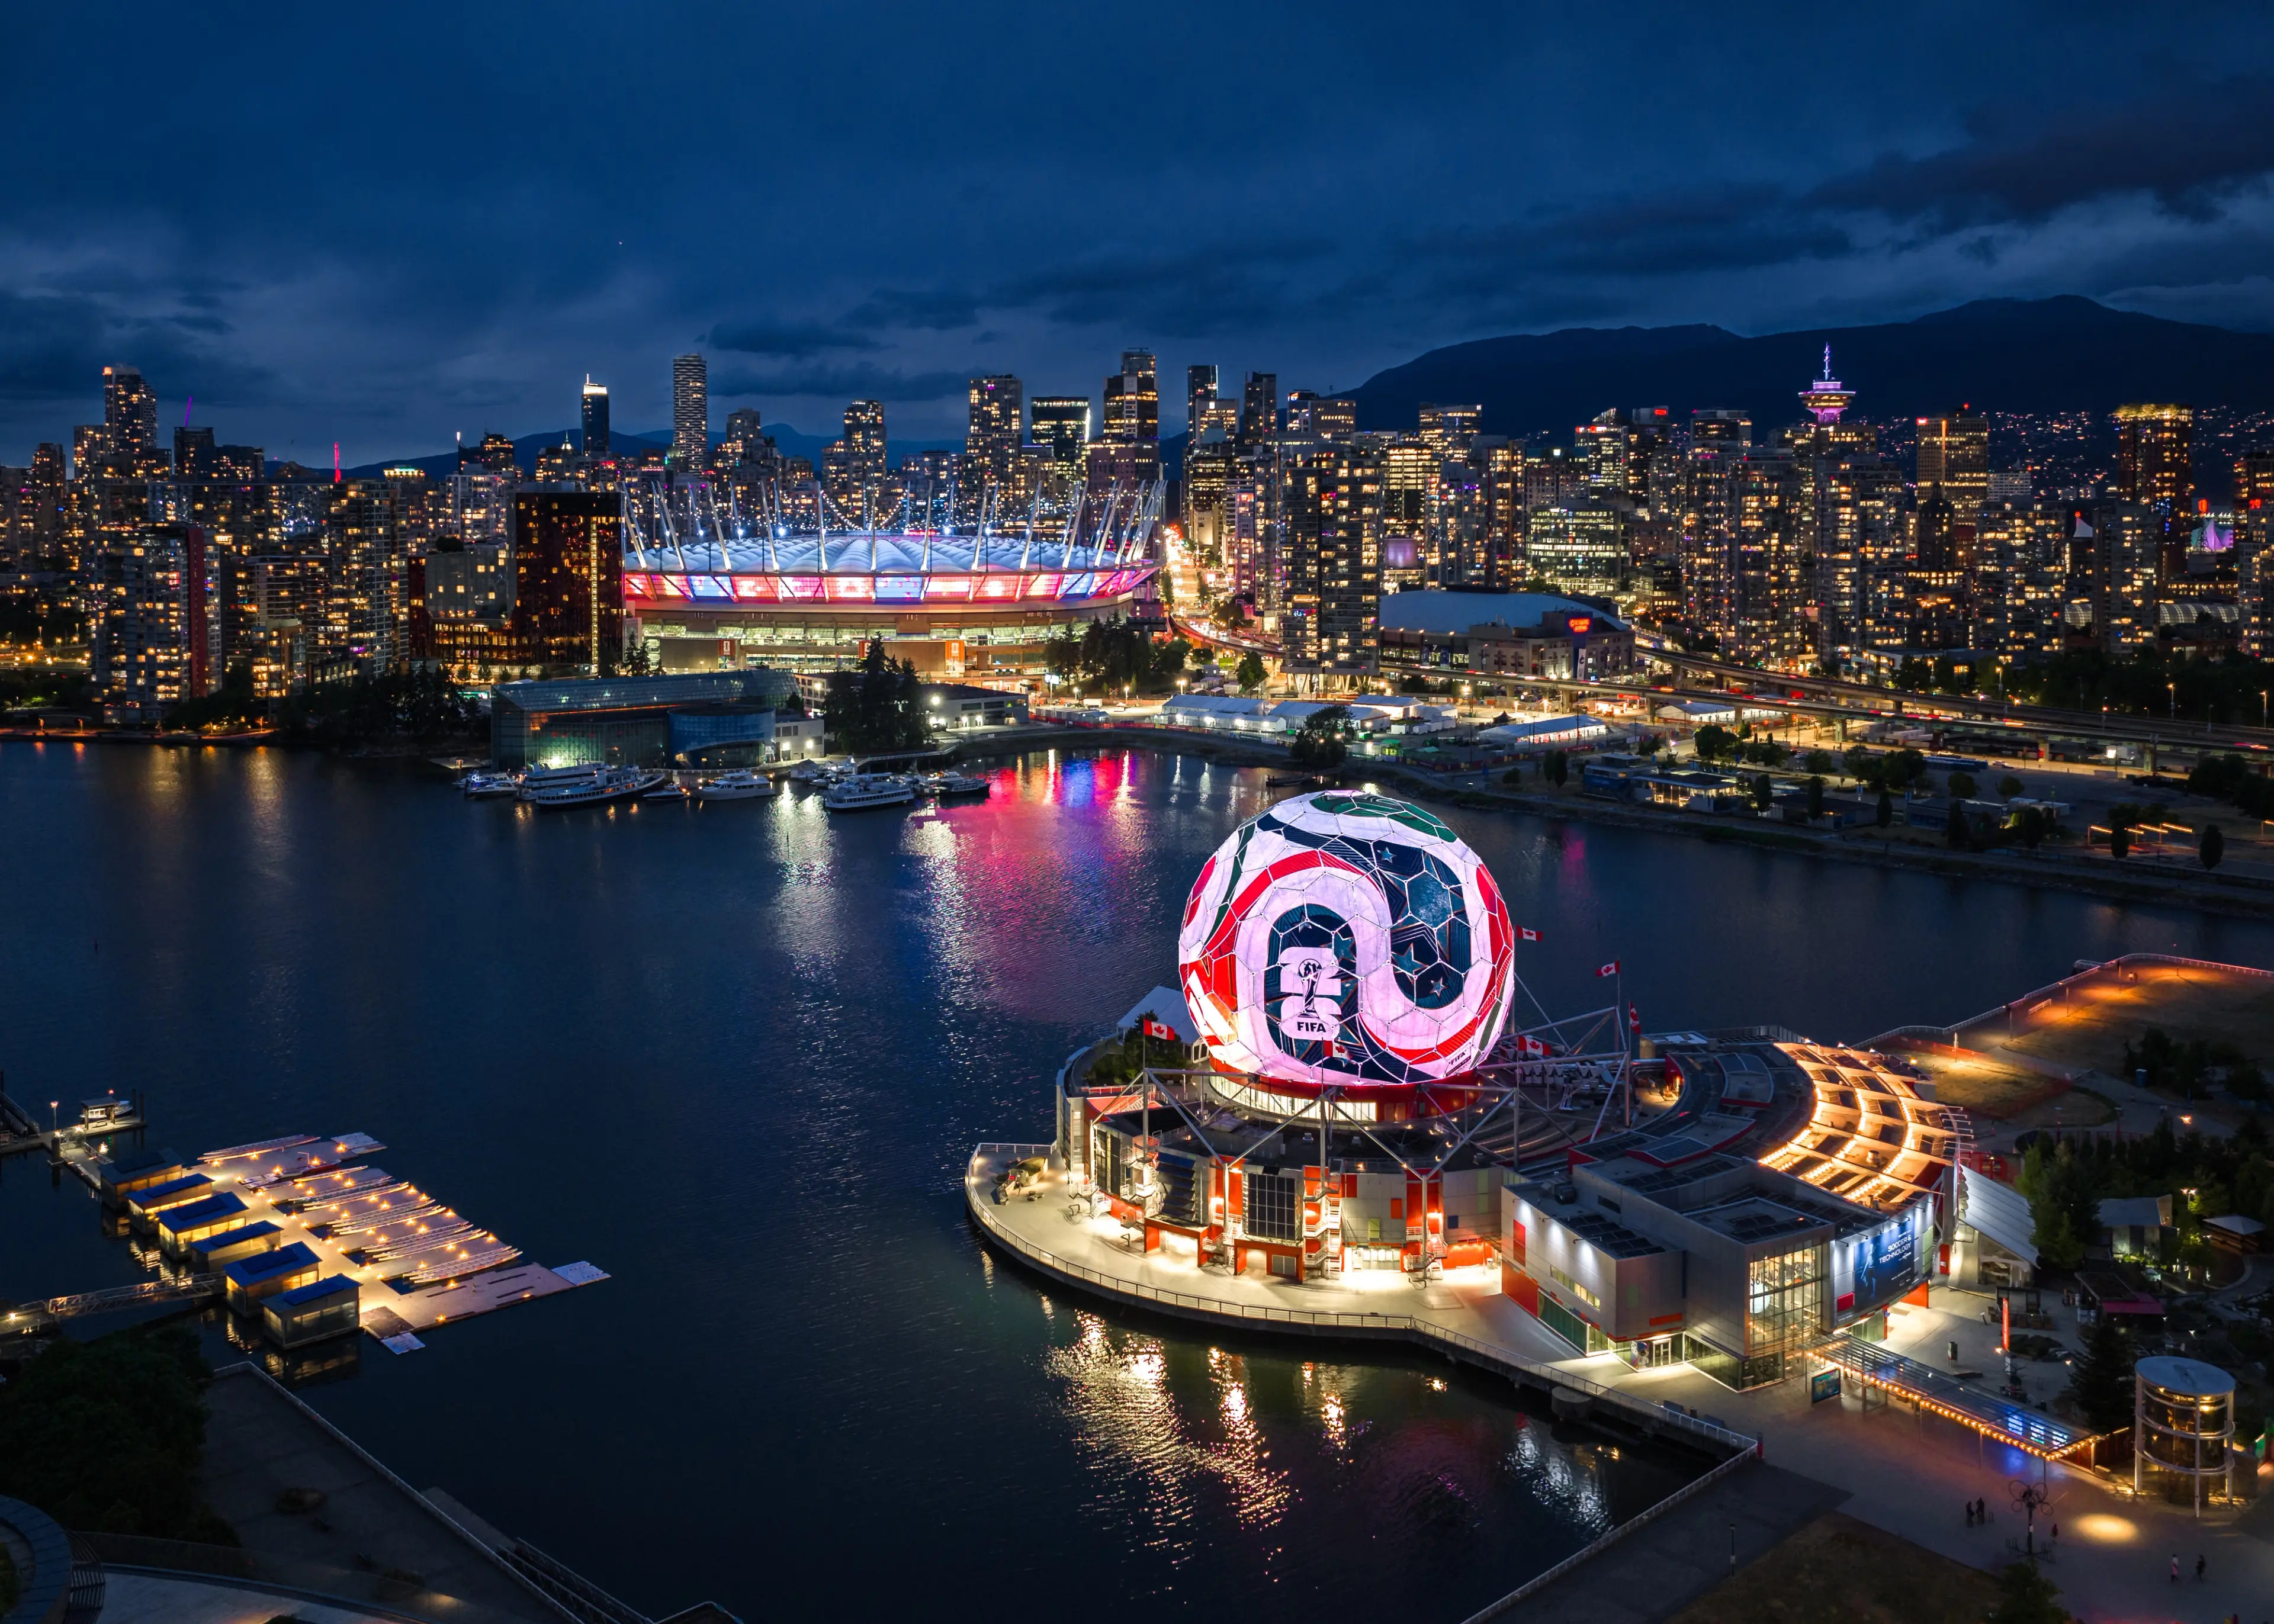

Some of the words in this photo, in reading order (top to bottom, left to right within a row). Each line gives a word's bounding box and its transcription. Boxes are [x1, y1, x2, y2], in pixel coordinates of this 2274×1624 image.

[1297, 1021, 1326, 1033] FIFA
[1451, 1051, 1466, 1065] FIFA
[1887, 1237, 1907, 1252] SOCCER
[1879, 1242, 1912, 1263] TECHNOLOGY
